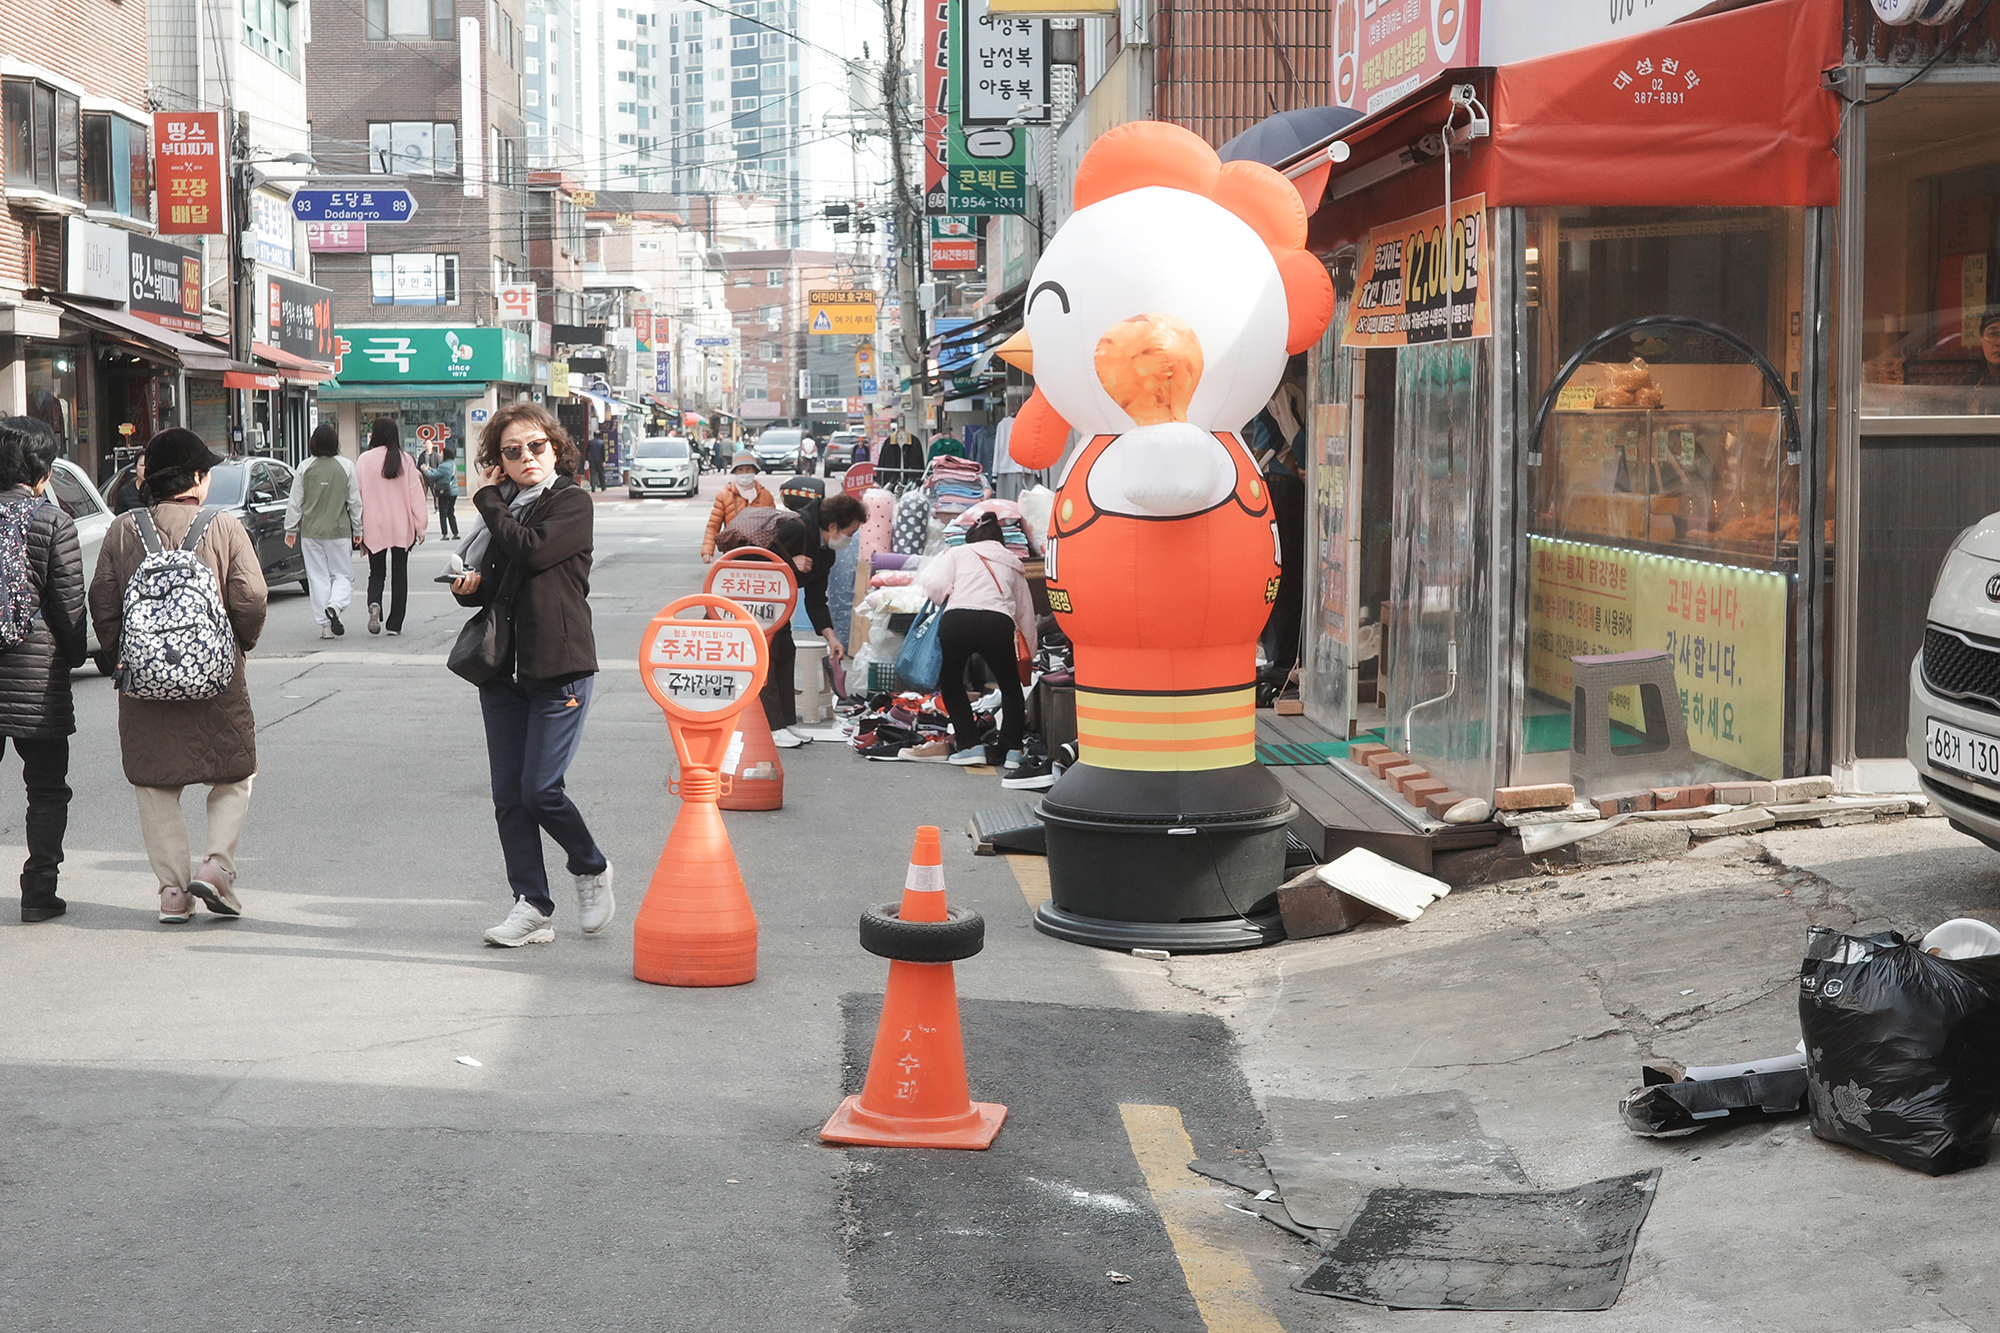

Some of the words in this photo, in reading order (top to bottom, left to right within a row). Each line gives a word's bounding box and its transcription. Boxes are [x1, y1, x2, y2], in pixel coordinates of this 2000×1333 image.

[979, 15, 1032, 36] 여성복
[979, 47, 1033, 68] 남성복
[1612, 57, 1701, 90] 대성천막
[979, 79, 1033, 101] 아동복
[1652, 78, 1663, 91] 02
[1634, 92, 1684, 104] 387-8891
[167, 122, 206, 141] 땅스
[161, 142, 214, 156] 부대찌개
[171, 178, 208, 197] 포장
[297, 200, 311, 212] 93
[330, 192, 374, 208] 도당로
[393, 200, 407, 212] 89
[950, 197, 1024, 208] T.954-1011
[171, 205, 209, 224] 배달
[325, 209, 380, 220] Dodang-ro
[86, 242, 104, 278] Lily
[106, 247, 111, 275] J
[932, 249, 975, 261] 24시간편의점
[1375, 240, 1402, 272] 후라이드
[1406, 212, 1480, 305] 12,000원
[131, 252, 155, 300] 땅스
[183, 261, 199, 286] TAKE
[185, 287, 198, 310] OUT
[812, 292, 872, 303] 어린이보호구역
[1358, 280, 1379, 309] 치킨
[1381, 277, 1403, 307] 1마리
[835, 315, 873, 324] 여기부터
[1396, 313, 1411, 331] 100%
[1557, 554, 1584, 583] 누룽지
[1590, 559, 1627, 591] 닭강정은
[721, 578, 781, 595] 주차금지
[1667, 578, 1744, 631] 고맙습니다.
[674, 629, 688, 638] 협조
[691, 629, 733, 639] 부탁드립니다
[1603, 608, 1632, 641] 사용하여
[661, 639, 745, 662] 주차금지
[1666, 630, 1742, 688] 감사합니다.
[669, 672, 735, 696] 주차장입구
